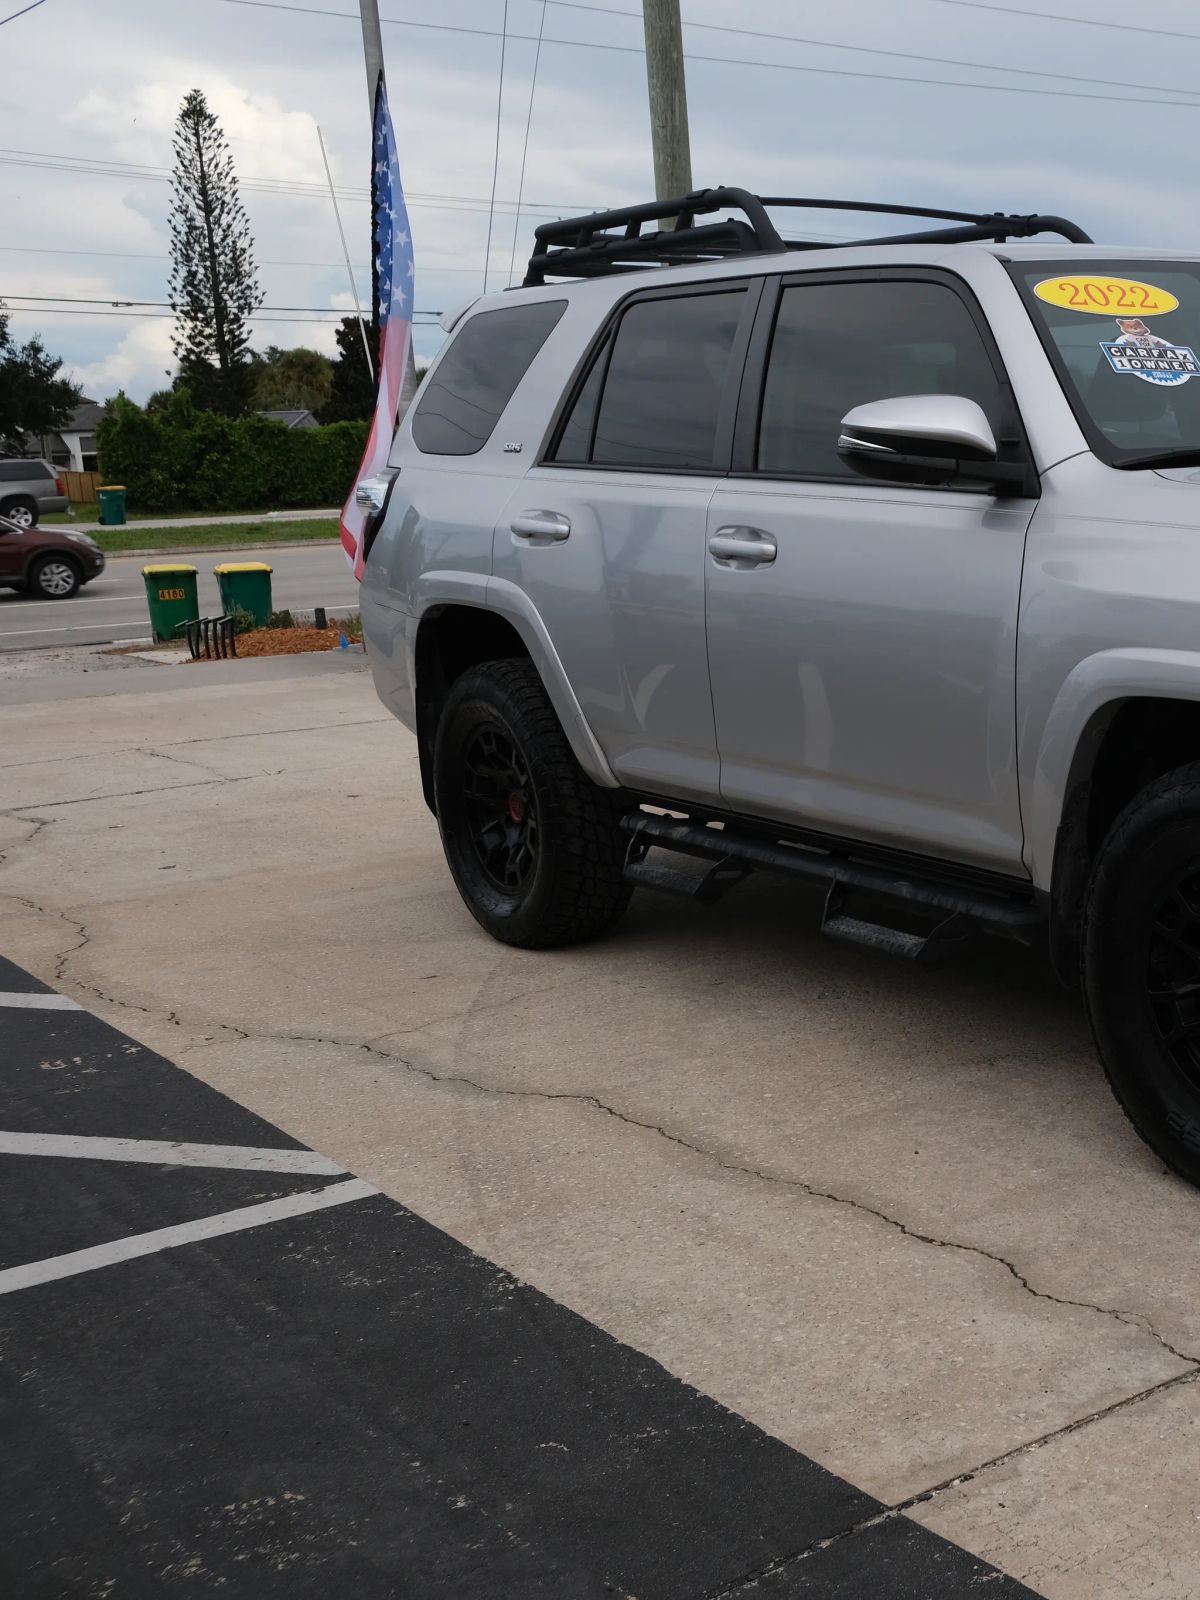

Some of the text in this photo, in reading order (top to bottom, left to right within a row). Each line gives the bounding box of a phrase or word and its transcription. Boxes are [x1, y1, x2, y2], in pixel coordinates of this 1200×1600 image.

[1058, 282, 1158, 309] 2022
[1110, 347, 1191, 361] CARFAX
[1117, 359, 1196, 372] 1 OWNER
